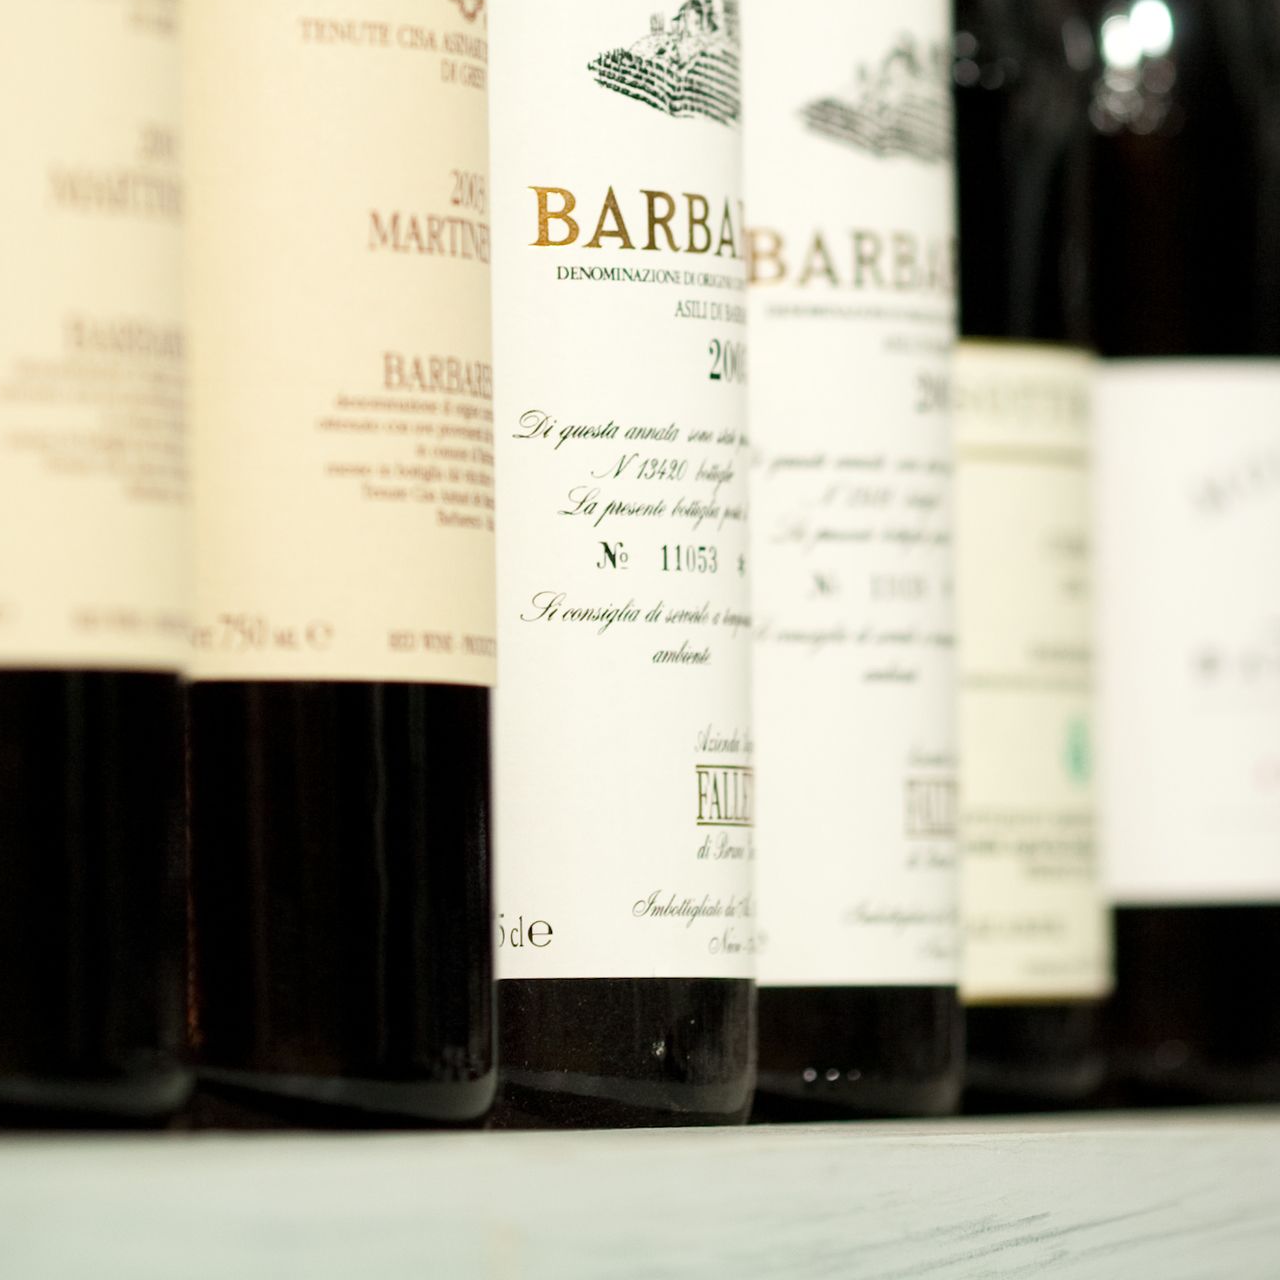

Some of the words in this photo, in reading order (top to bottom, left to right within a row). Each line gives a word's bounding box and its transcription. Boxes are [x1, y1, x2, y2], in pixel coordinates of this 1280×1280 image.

[556, 266, 681, 285] DENOMINAZIONE
[554, 420, 621, 450] questa
[624, 422, 681, 443] annata
[593, 499, 665, 528] presente
[661, 543, 718, 574] 11053
[561, 597, 642, 635] consiglia
[644, 599, 664, 622] di
